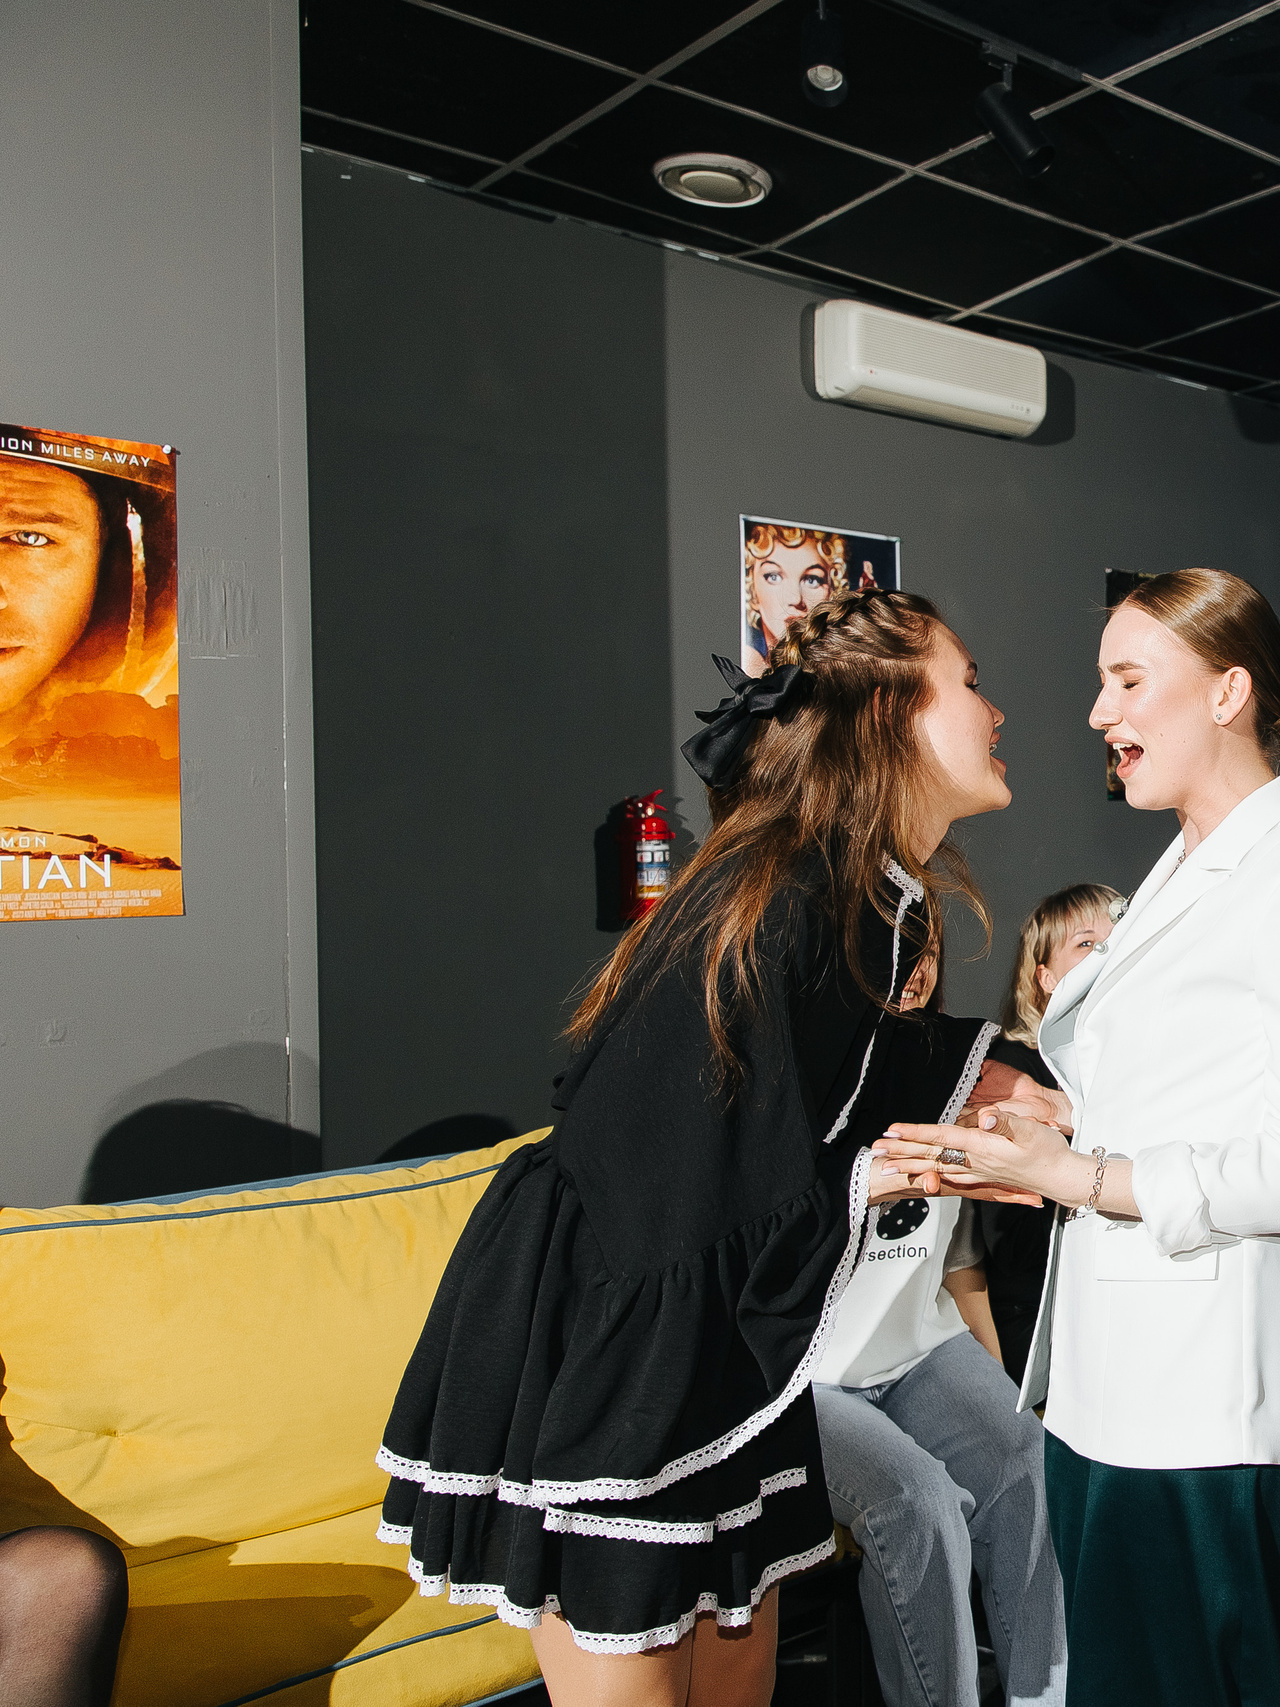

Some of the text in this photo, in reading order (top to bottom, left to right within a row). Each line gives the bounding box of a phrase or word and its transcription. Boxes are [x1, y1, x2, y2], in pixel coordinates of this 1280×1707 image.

[41, 442, 95, 460] MILES
[102, 451, 150, 467] AWAY
[0, 836, 47, 848] MON
